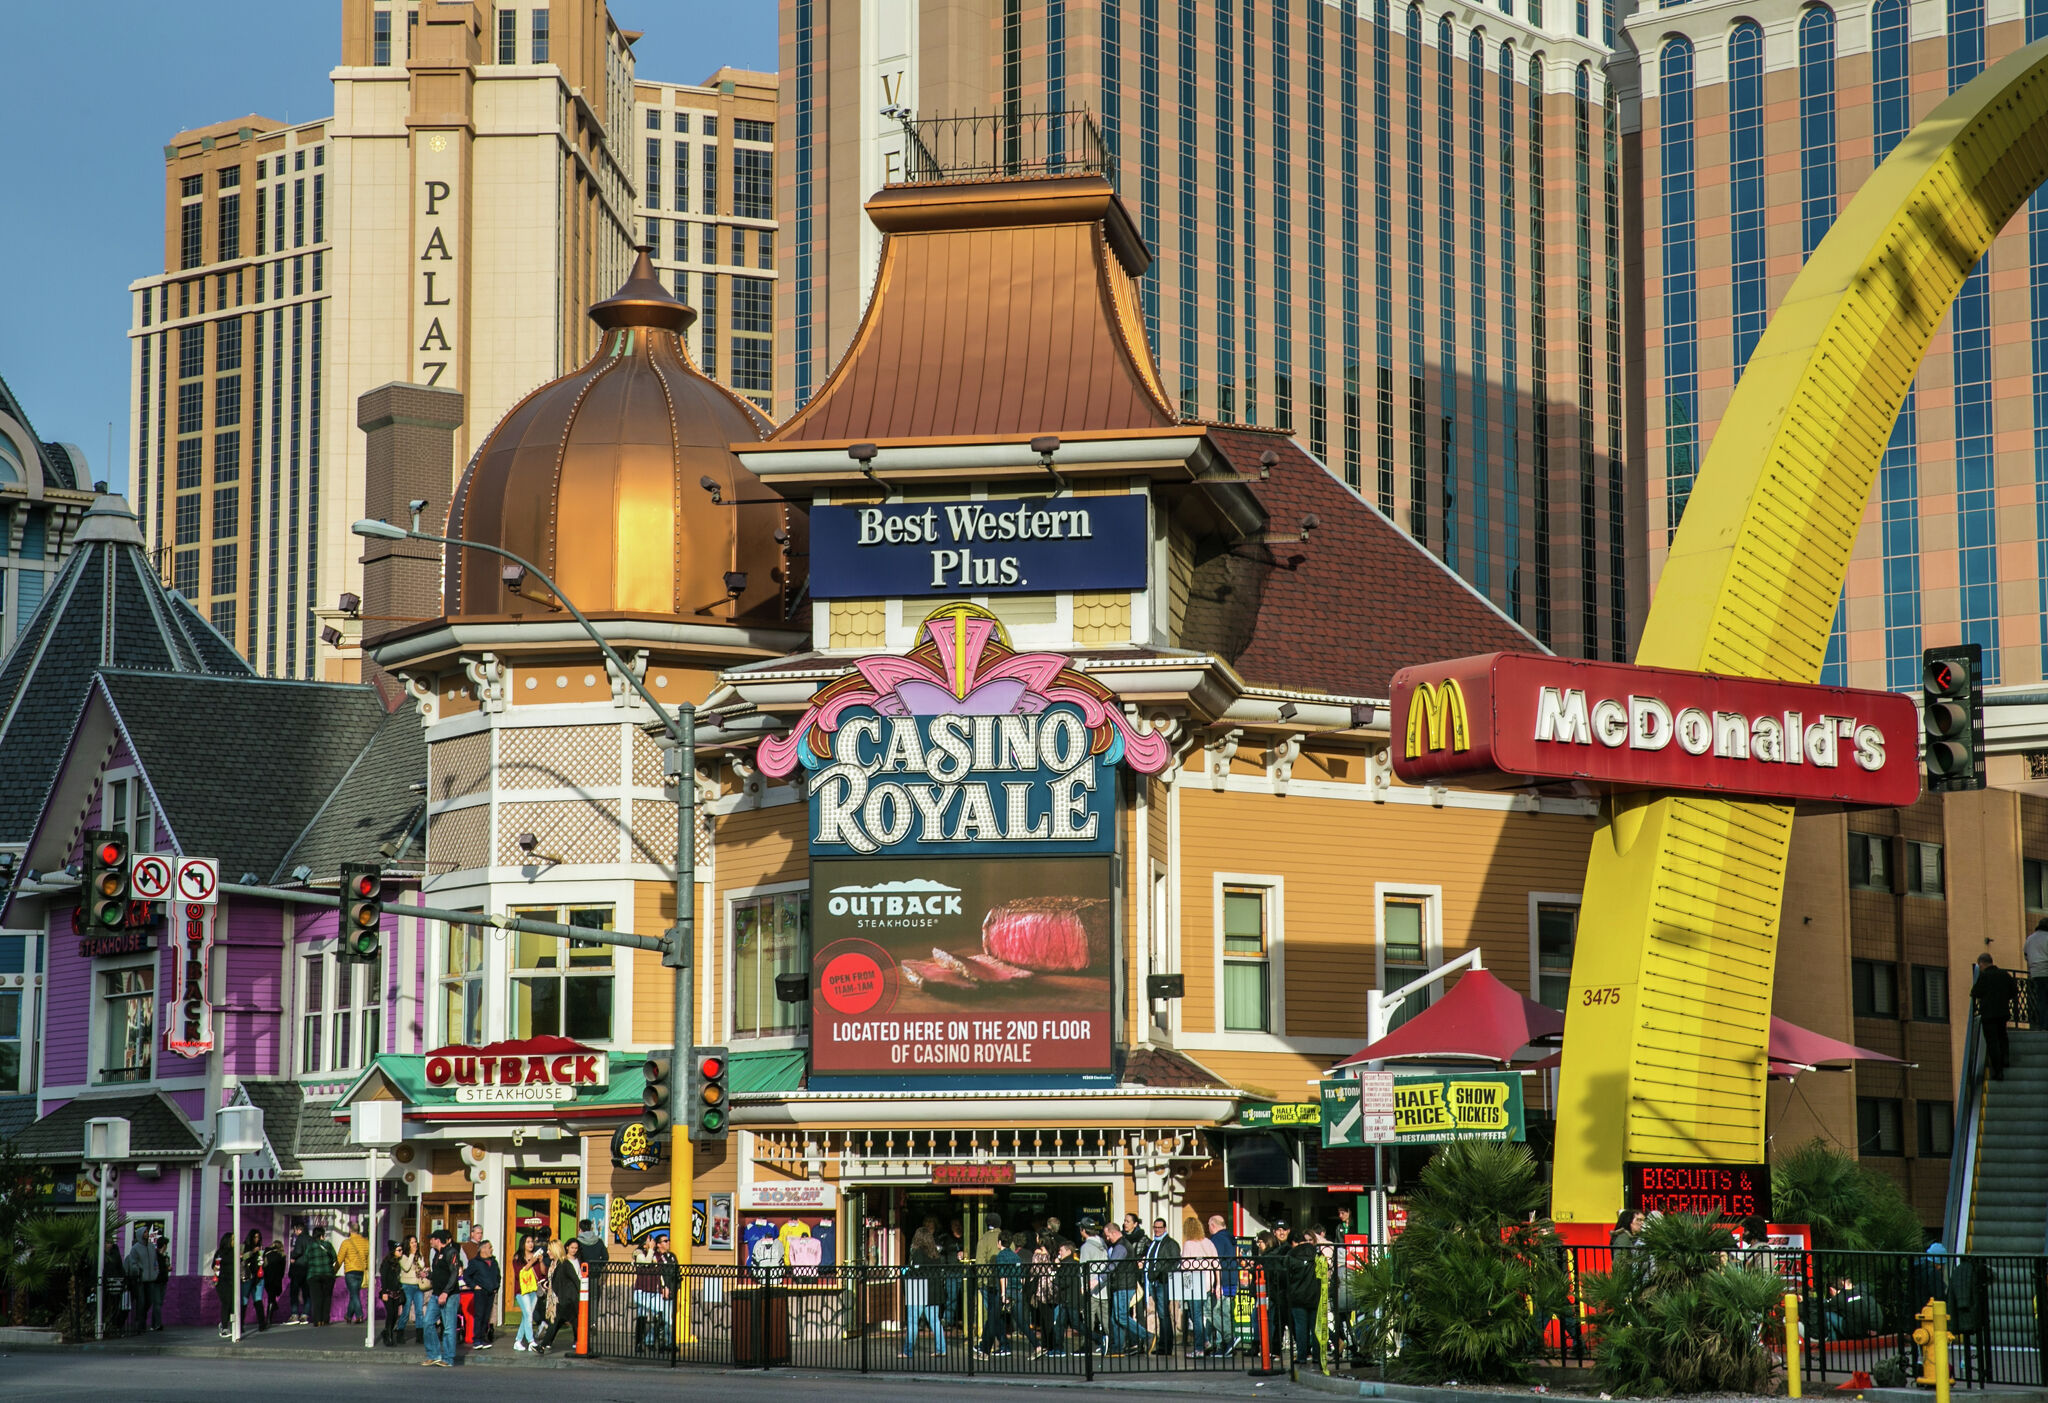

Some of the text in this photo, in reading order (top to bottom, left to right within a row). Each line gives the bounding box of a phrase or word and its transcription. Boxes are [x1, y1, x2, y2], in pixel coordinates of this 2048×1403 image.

[857, 503, 1092, 545] Best Western
[1534, 686, 1886, 772] McDonald's
[836, 711, 1088, 784] CASINO
[809, 756, 1100, 855] ROYALE
[828, 895, 962, 916] OUTBACK
[79, 934, 140, 957] STEAKHOUSE
[184, 902, 205, 1042] OUTBACK
[829, 970, 875, 985] OPEN FROM
[1582, 987, 1621, 1006] 3475
[833, 1020, 1091, 1041] LOCATED HERE ON THE 2ND FLOOR
[891, 1043, 1031, 1063] OF CASINO ROYALE
[426, 1057, 598, 1085] OUTBACK
[467, 1088, 562, 1100] STEAKHOUSE
[1395, 1089, 1439, 1108] HALF
[1456, 1087, 1496, 1105] SHOW
[1395, 1107, 1445, 1126] PRICE
[1457, 1105, 1500, 1124] TICKETS
[1402, 1132, 1456, 1143] RESTAURANTS
[935, 1165, 1012, 1178] OUTBACK
[1643, 1168, 1752, 1190] BISCUITS &
[1641, 1194, 1755, 1216] MCGRIDDLES
